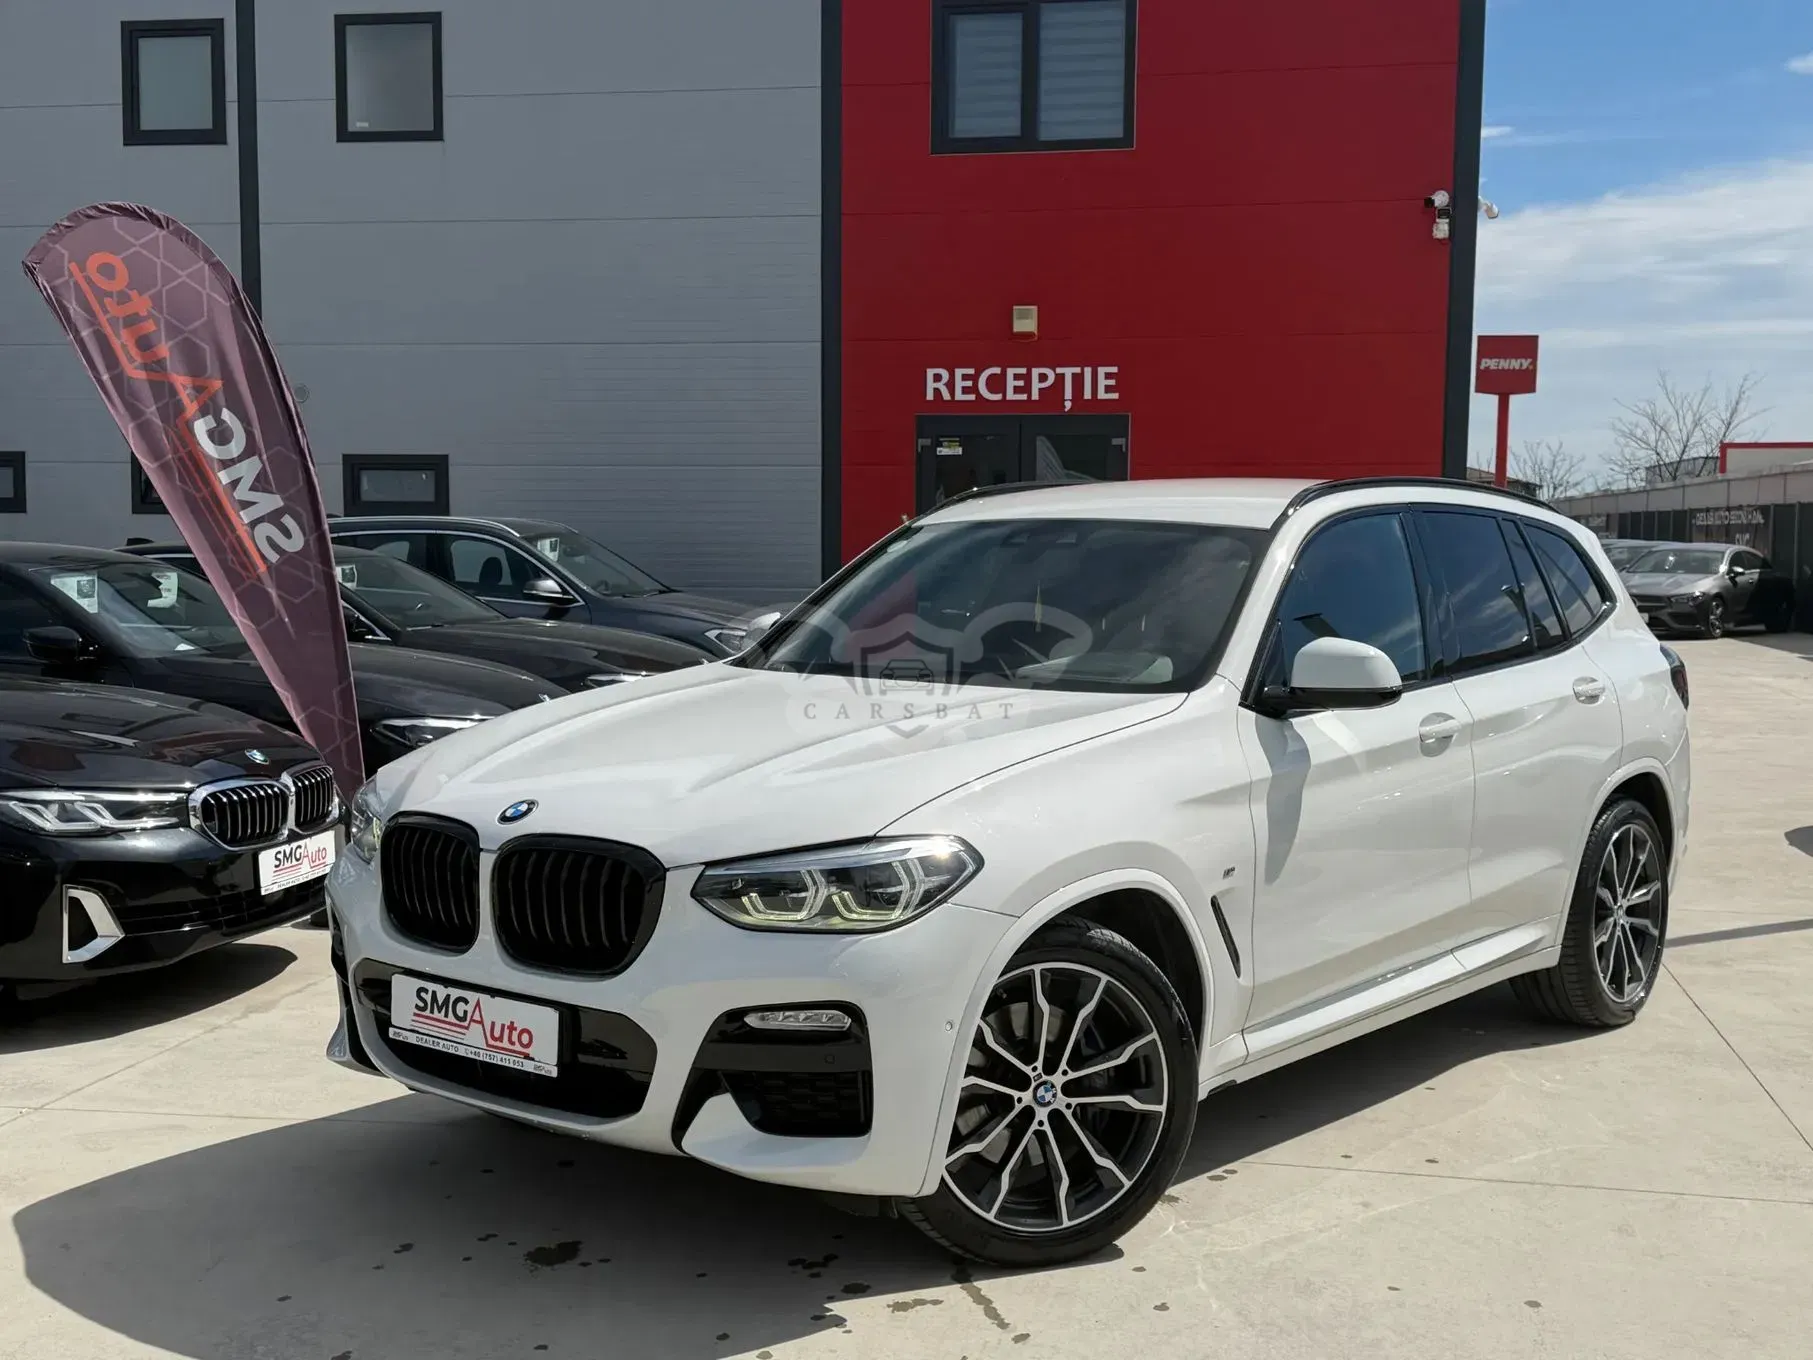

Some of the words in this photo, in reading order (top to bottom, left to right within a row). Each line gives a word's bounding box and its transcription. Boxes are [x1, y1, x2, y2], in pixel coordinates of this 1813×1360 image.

[925, 366, 1120, 412] RECEPȚIE
[415, 1035, 441, 1048] DEALER
[441, 1043, 459, 1053] AUTO
